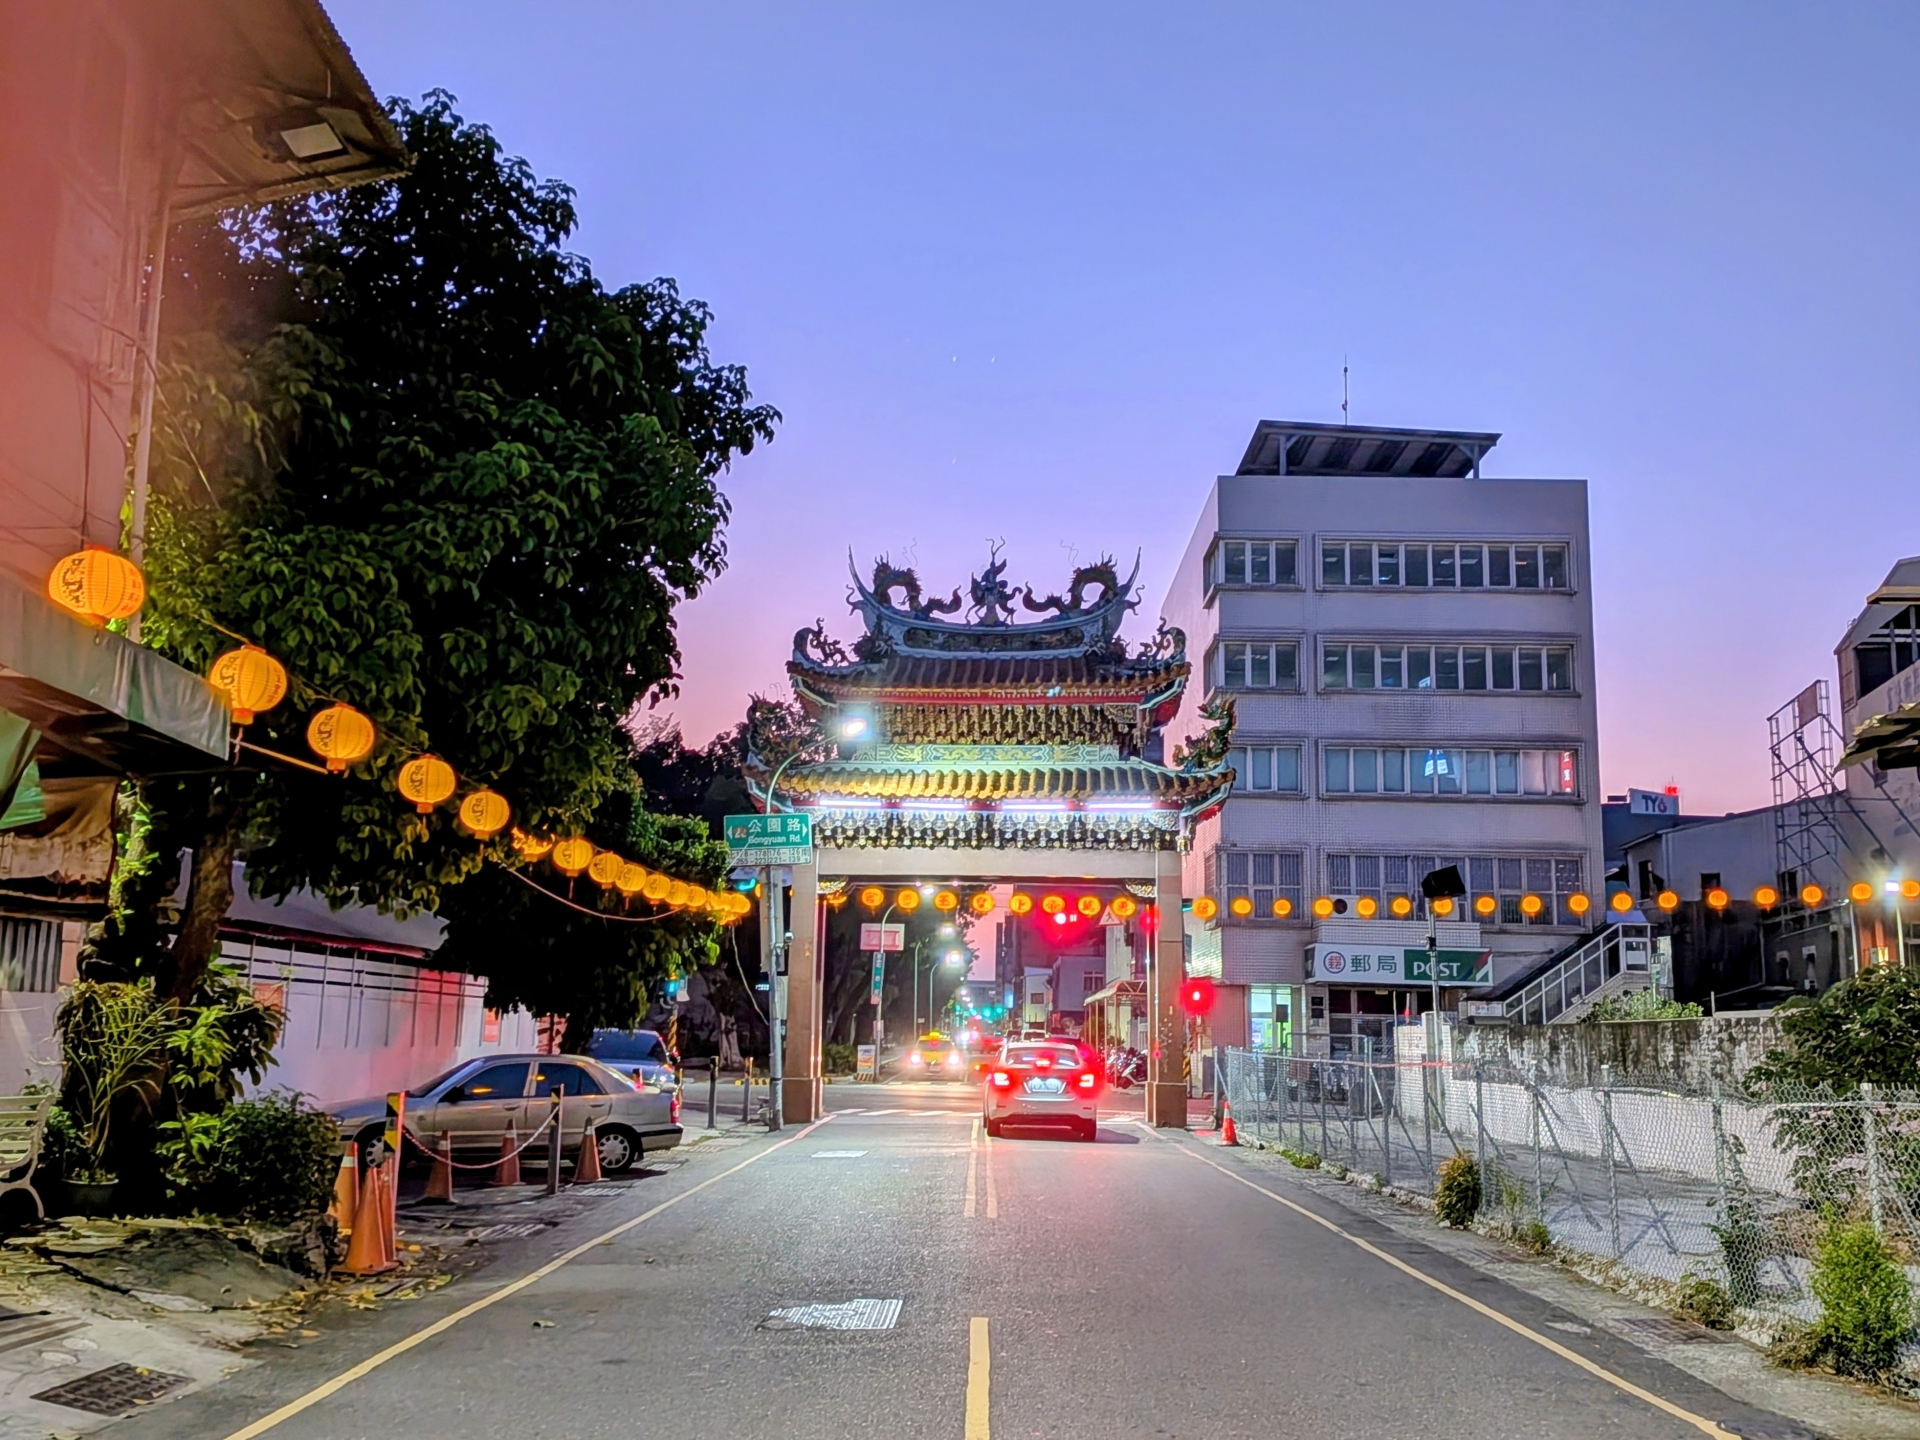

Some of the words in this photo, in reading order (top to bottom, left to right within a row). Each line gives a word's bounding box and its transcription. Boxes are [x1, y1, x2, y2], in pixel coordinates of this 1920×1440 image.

[748, 818, 801, 833] 公園路
[748, 835, 786, 845] Gongyuan
[789, 834, 802, 843] Rd.
[1350, 954, 1397, 973] 郵局
